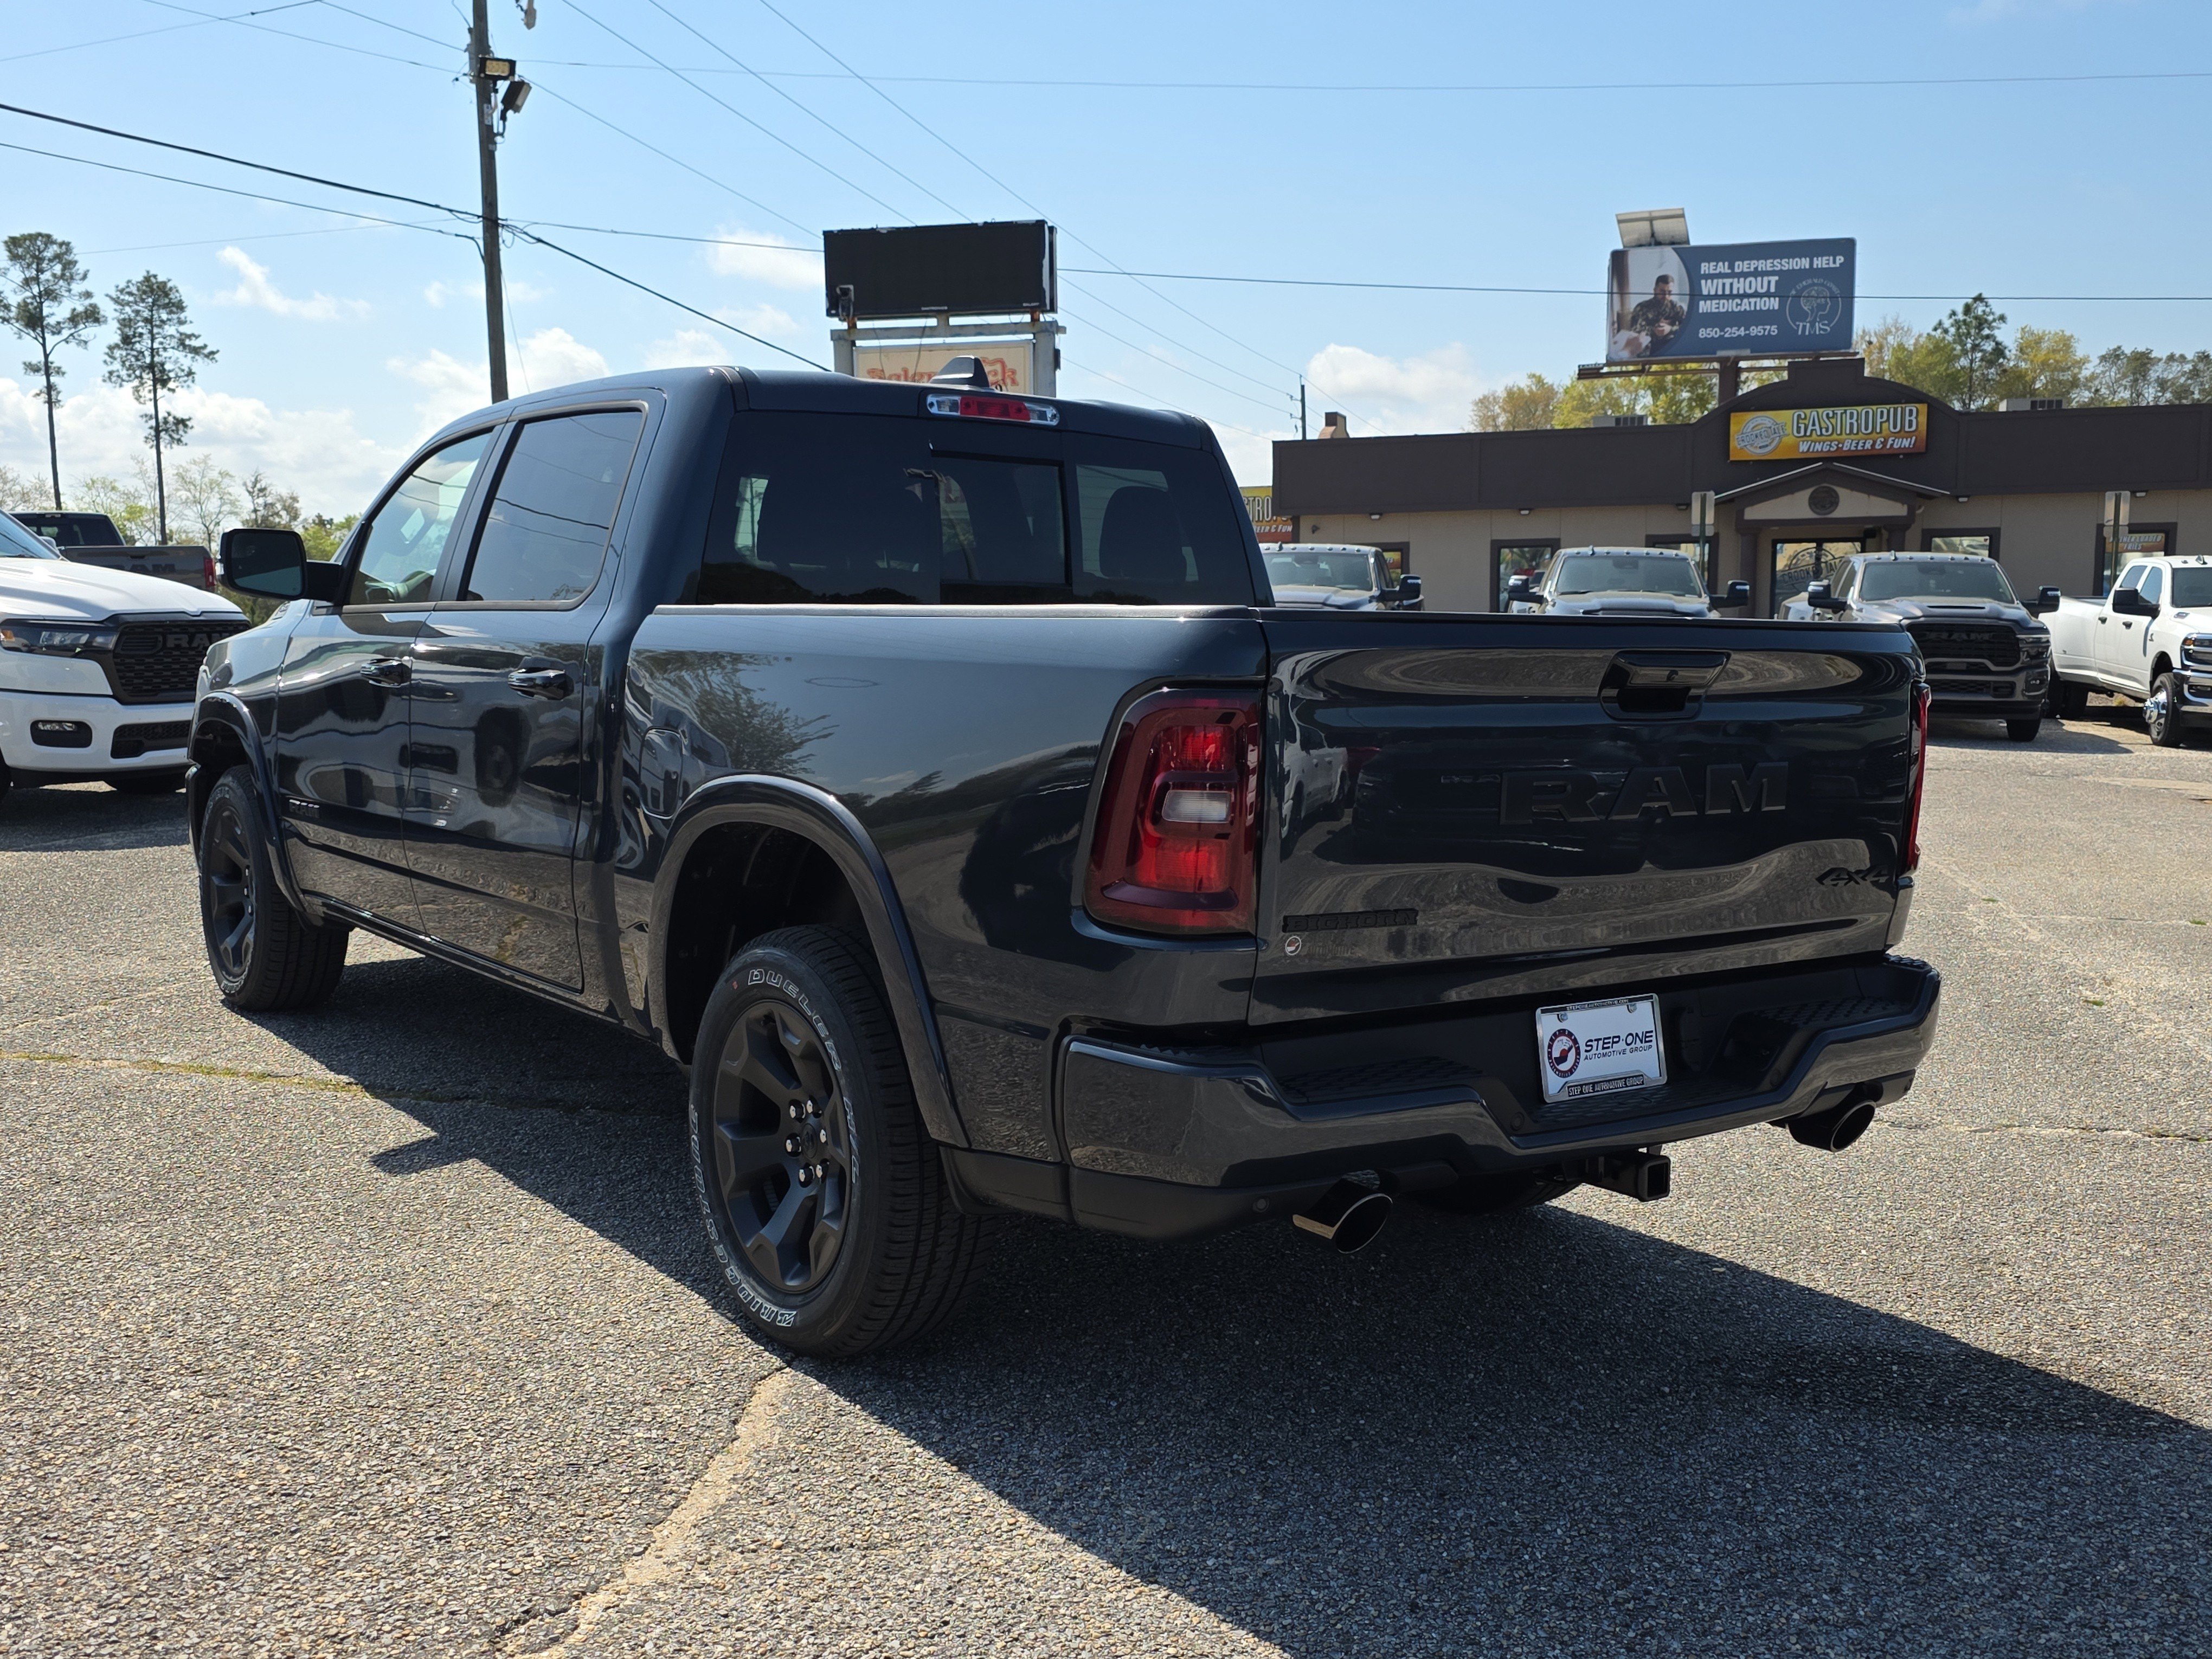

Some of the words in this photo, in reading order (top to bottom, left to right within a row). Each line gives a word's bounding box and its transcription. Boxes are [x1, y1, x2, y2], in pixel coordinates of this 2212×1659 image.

[1701, 262, 1732, 274] REAL
[1734, 257, 1810, 273] DEPRESSION
[1813, 255, 1844, 268] HELP
[1700, 275, 1779, 295] WITHOUT
[1699, 297, 1779, 313] MEDICATION
[1699, 325, 1778, 339] 850-254-9575
[1796, 320, 1831, 336] TMS
[1792, 406, 1917, 437] GASTROPUB
[1886, 436, 1916, 449] FUN!
[1500, 761, 1789, 825] RAM
[748, 968, 841, 1071] DUELER
[1584, 1048, 1627, 1061] AUTOMOTIVE
[1629, 1045, 1653, 1054] GROUP
[1568, 1086, 1581, 1096] STEP
[1583, 1084, 1593, 1093] ONE
[1594, 1079, 1626, 1091] AUTOMOTIVE
[1626, 1076, 1643, 1085] GROUP
